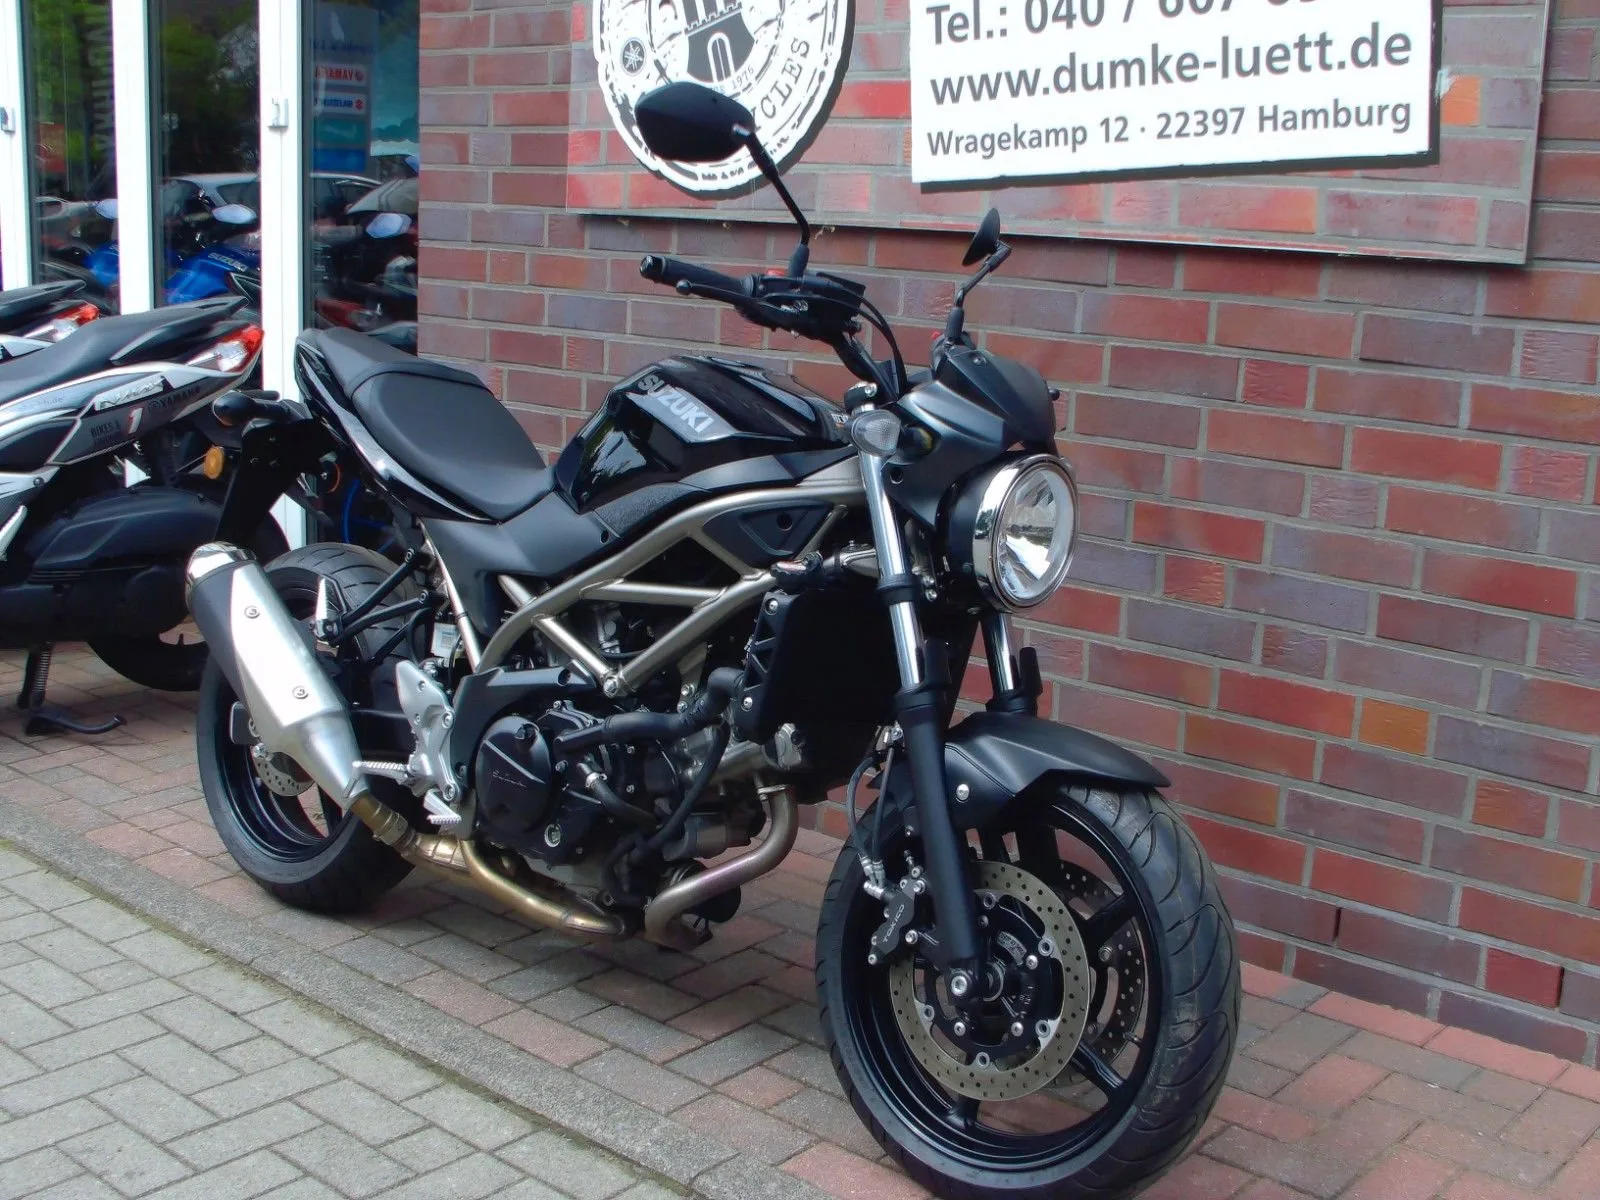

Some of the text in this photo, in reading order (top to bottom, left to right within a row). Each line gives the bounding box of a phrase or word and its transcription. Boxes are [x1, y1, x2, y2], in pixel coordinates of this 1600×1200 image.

[926, 0, 1008, 45] Tel.:
[1025, 0, 1105, 34] 040
[930, 21, 1412, 106] www.dumke-luett.de
[926, 99, 1411, 160] Wragekamp 12 22397 Hamburg
[638, 374, 714, 433] SUZUKI
[882, 904, 905, 943] TOKICO
